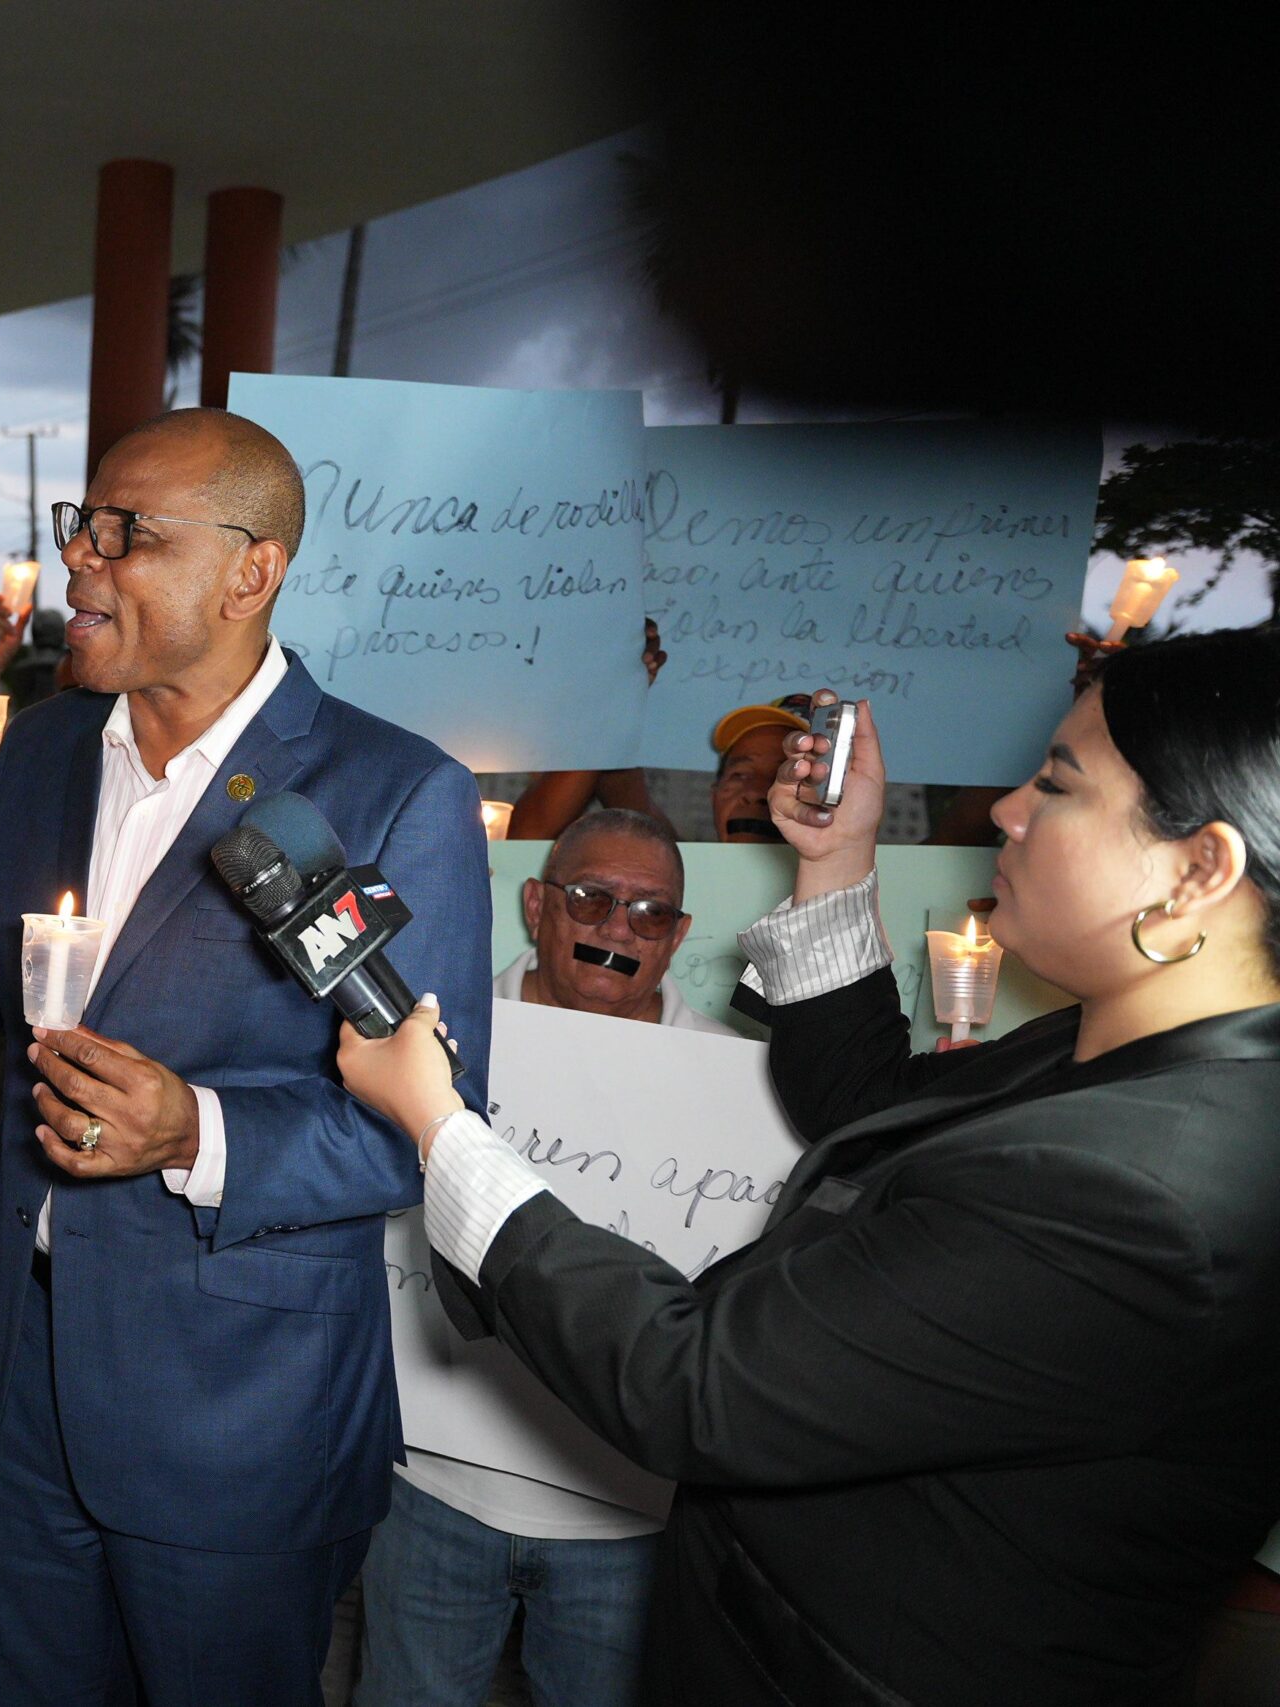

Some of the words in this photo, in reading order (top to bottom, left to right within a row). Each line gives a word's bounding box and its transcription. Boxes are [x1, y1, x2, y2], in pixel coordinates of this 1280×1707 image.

[302, 459, 478, 545] Nunca
[491, 487, 539, 535] de
[281, 554, 358, 597] nte
[780, 600, 824, 644] la
[845, 602, 1033, 655] libertad
